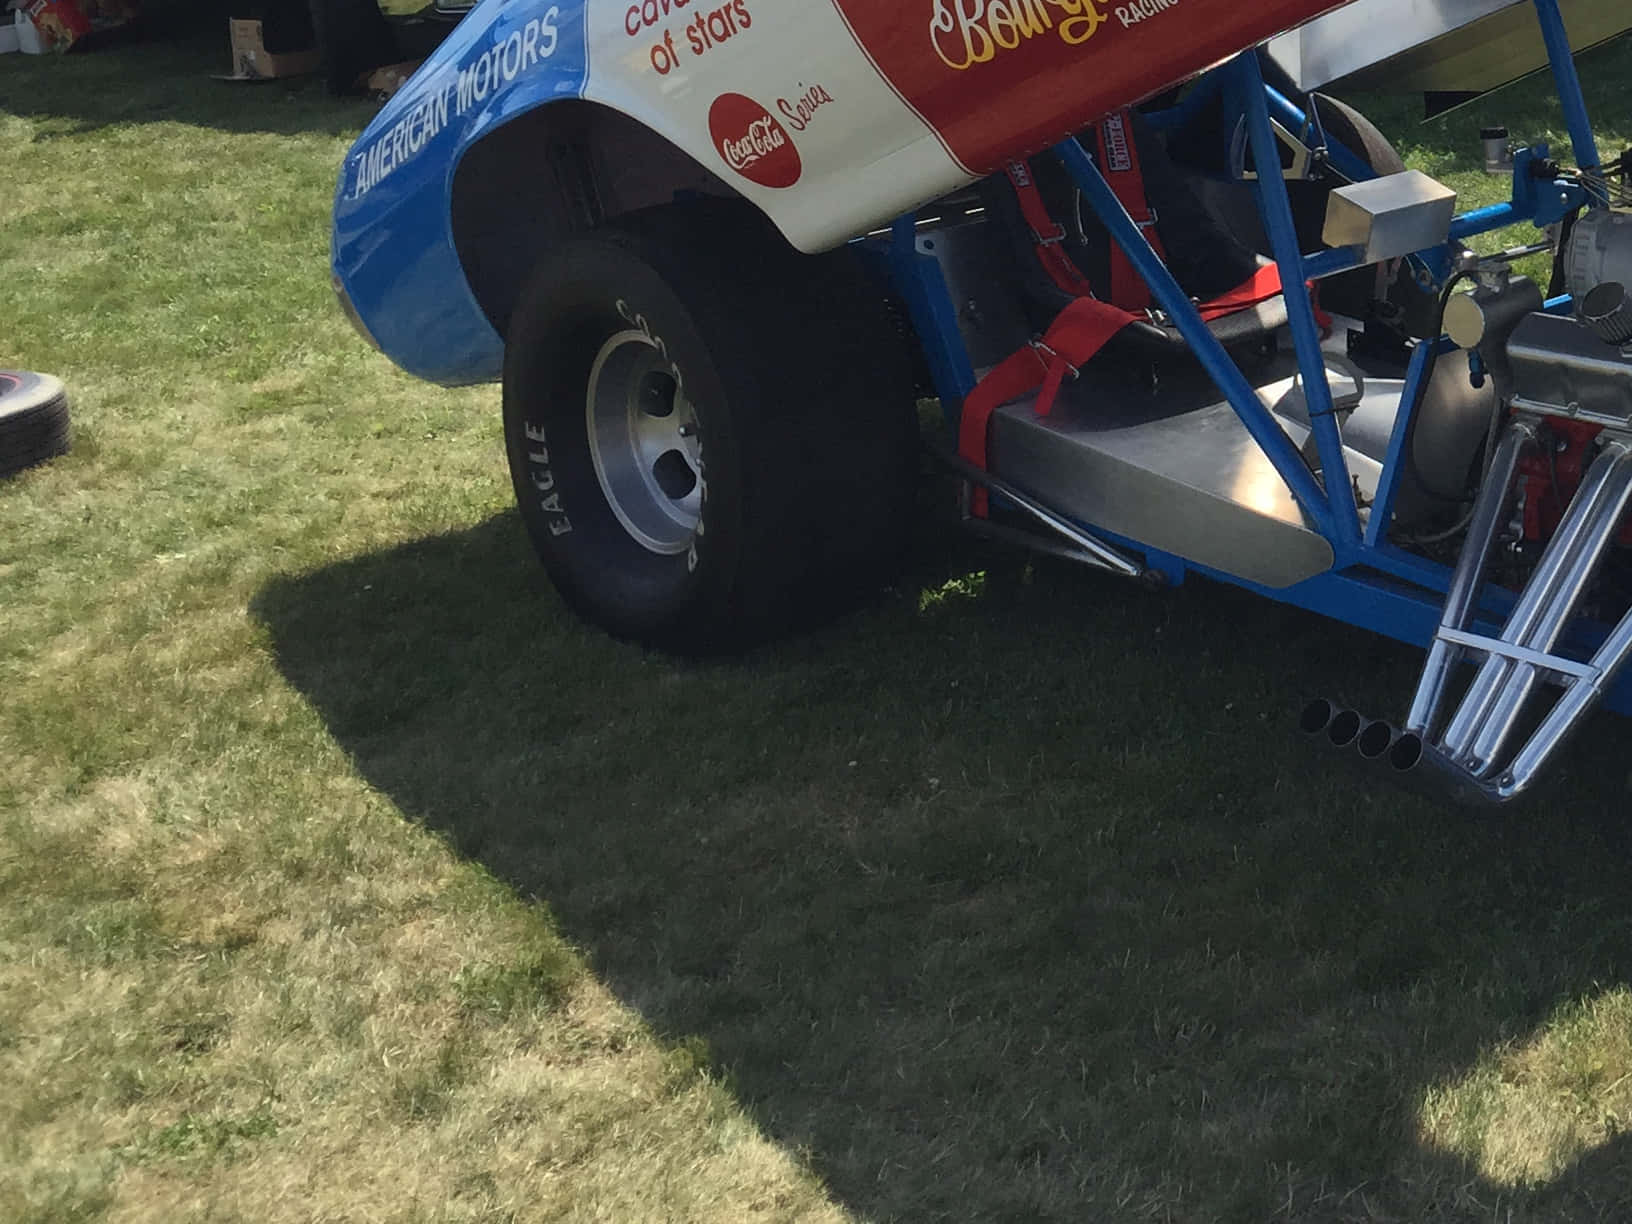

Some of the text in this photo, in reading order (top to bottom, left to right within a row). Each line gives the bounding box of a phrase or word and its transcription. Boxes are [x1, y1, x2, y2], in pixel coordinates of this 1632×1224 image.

[650, 28, 681, 75] of
[353, 6, 560, 200] AMERICAN MOTORS
[776, 81, 834, 131] Series
[524, 420, 573, 537] EAGLE
